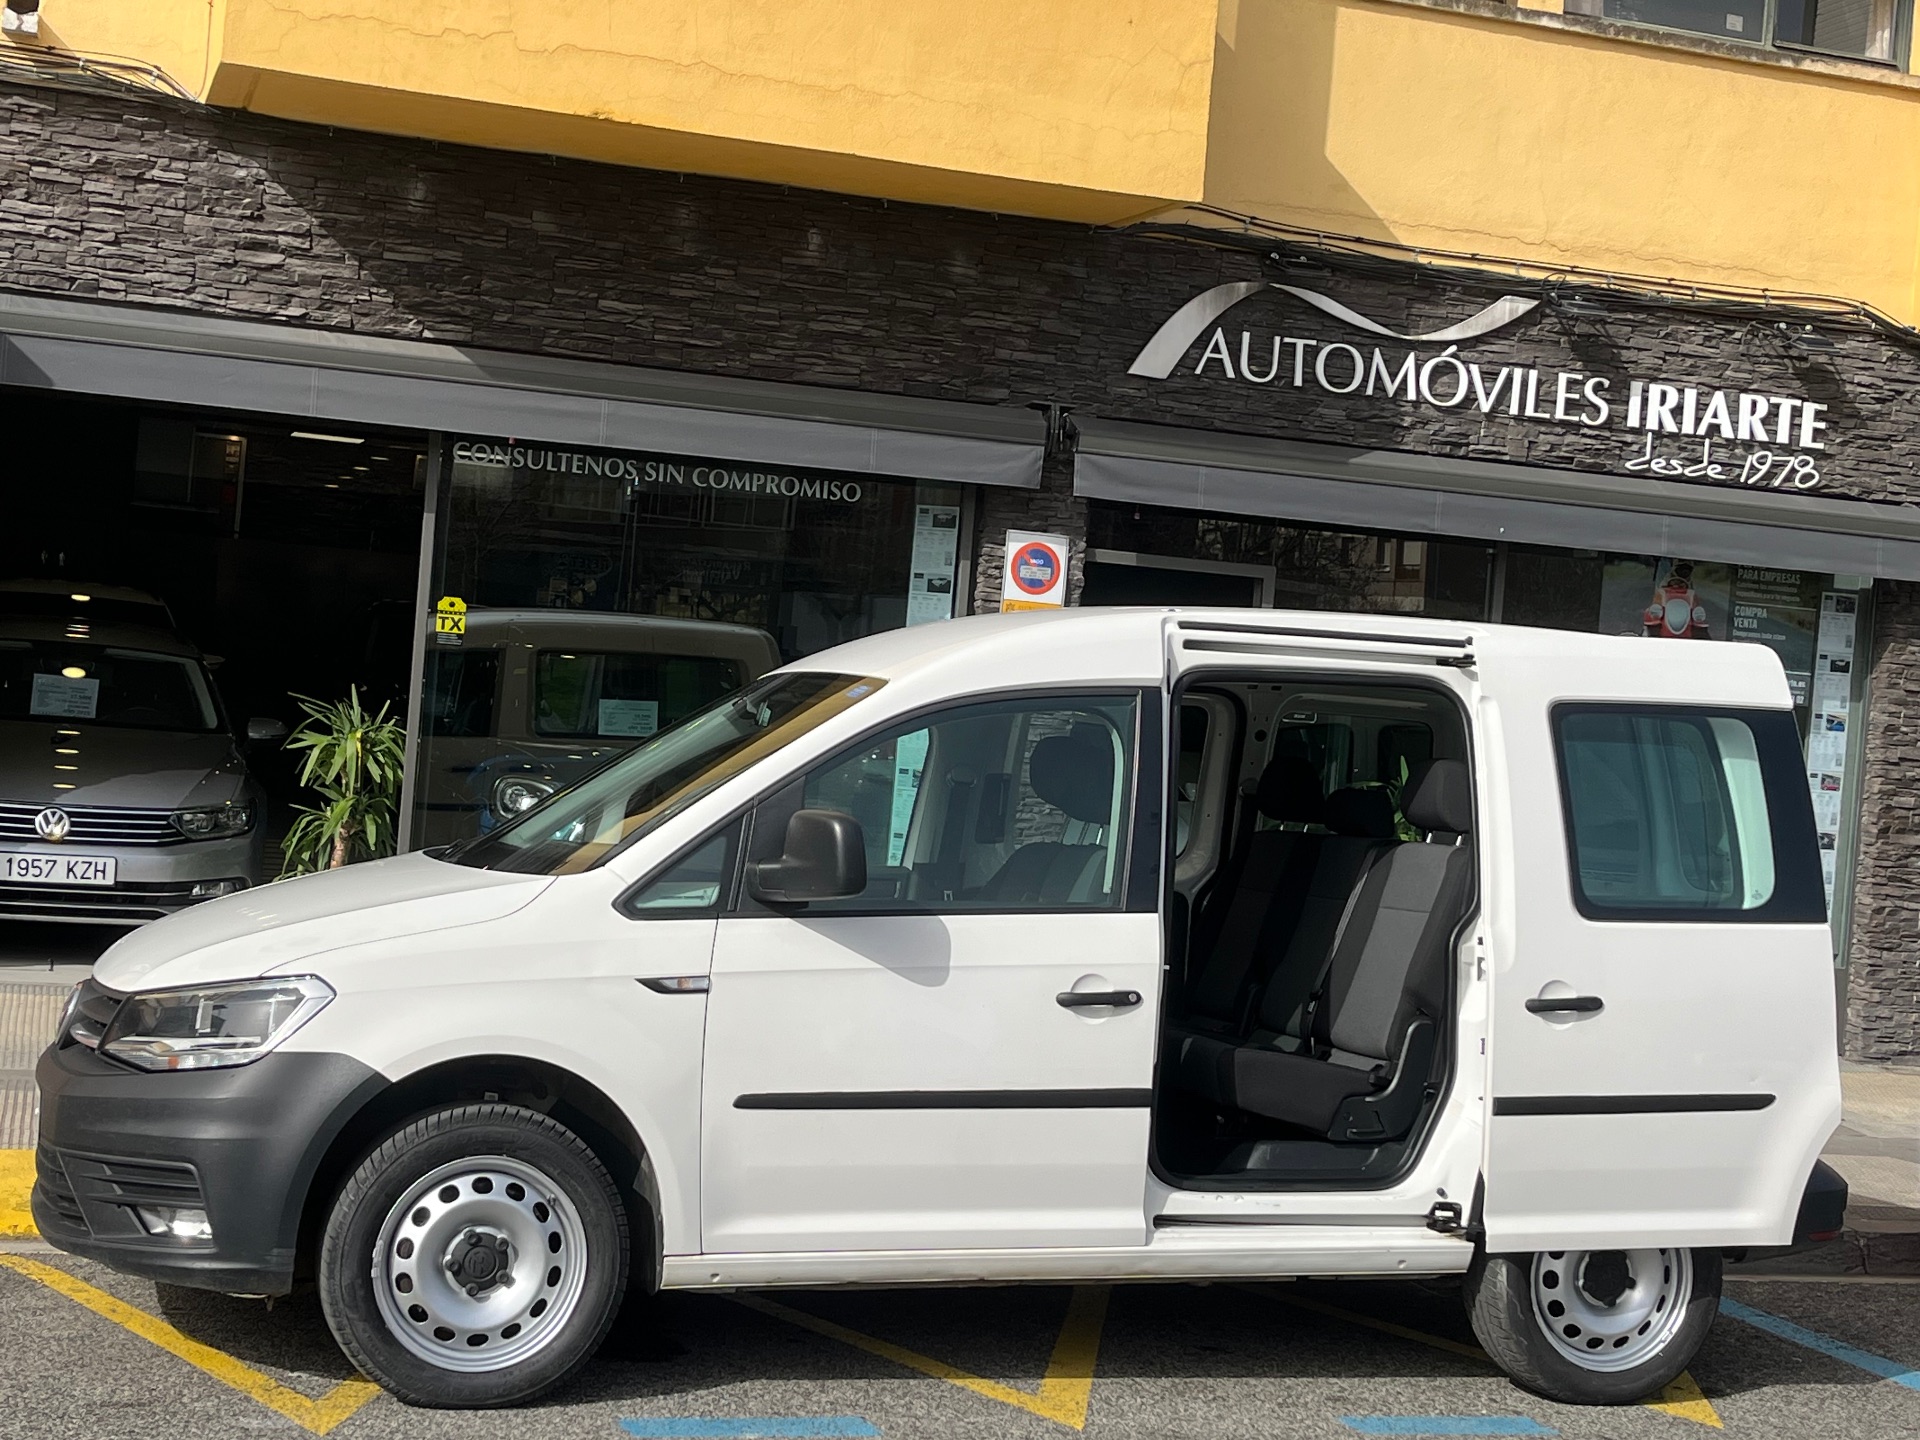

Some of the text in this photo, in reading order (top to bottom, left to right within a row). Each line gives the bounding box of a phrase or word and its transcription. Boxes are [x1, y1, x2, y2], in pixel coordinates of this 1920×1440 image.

[1194, 326, 1828, 450] AUTOMÓVILES IRIARTE
[1624, 431, 1821, 489] desde 1978
[452, 441, 862, 502] CONSULTENOS SIN COMPROMISO
[1737, 568, 1801, 585] PARA EMPRESAS
[1734, 605, 1768, 619] COMPRA
[438, 615, 463, 632] TX
[1733, 616, 1758, 629] VENTA
[6, 857, 107, 881] 1957 KZH
